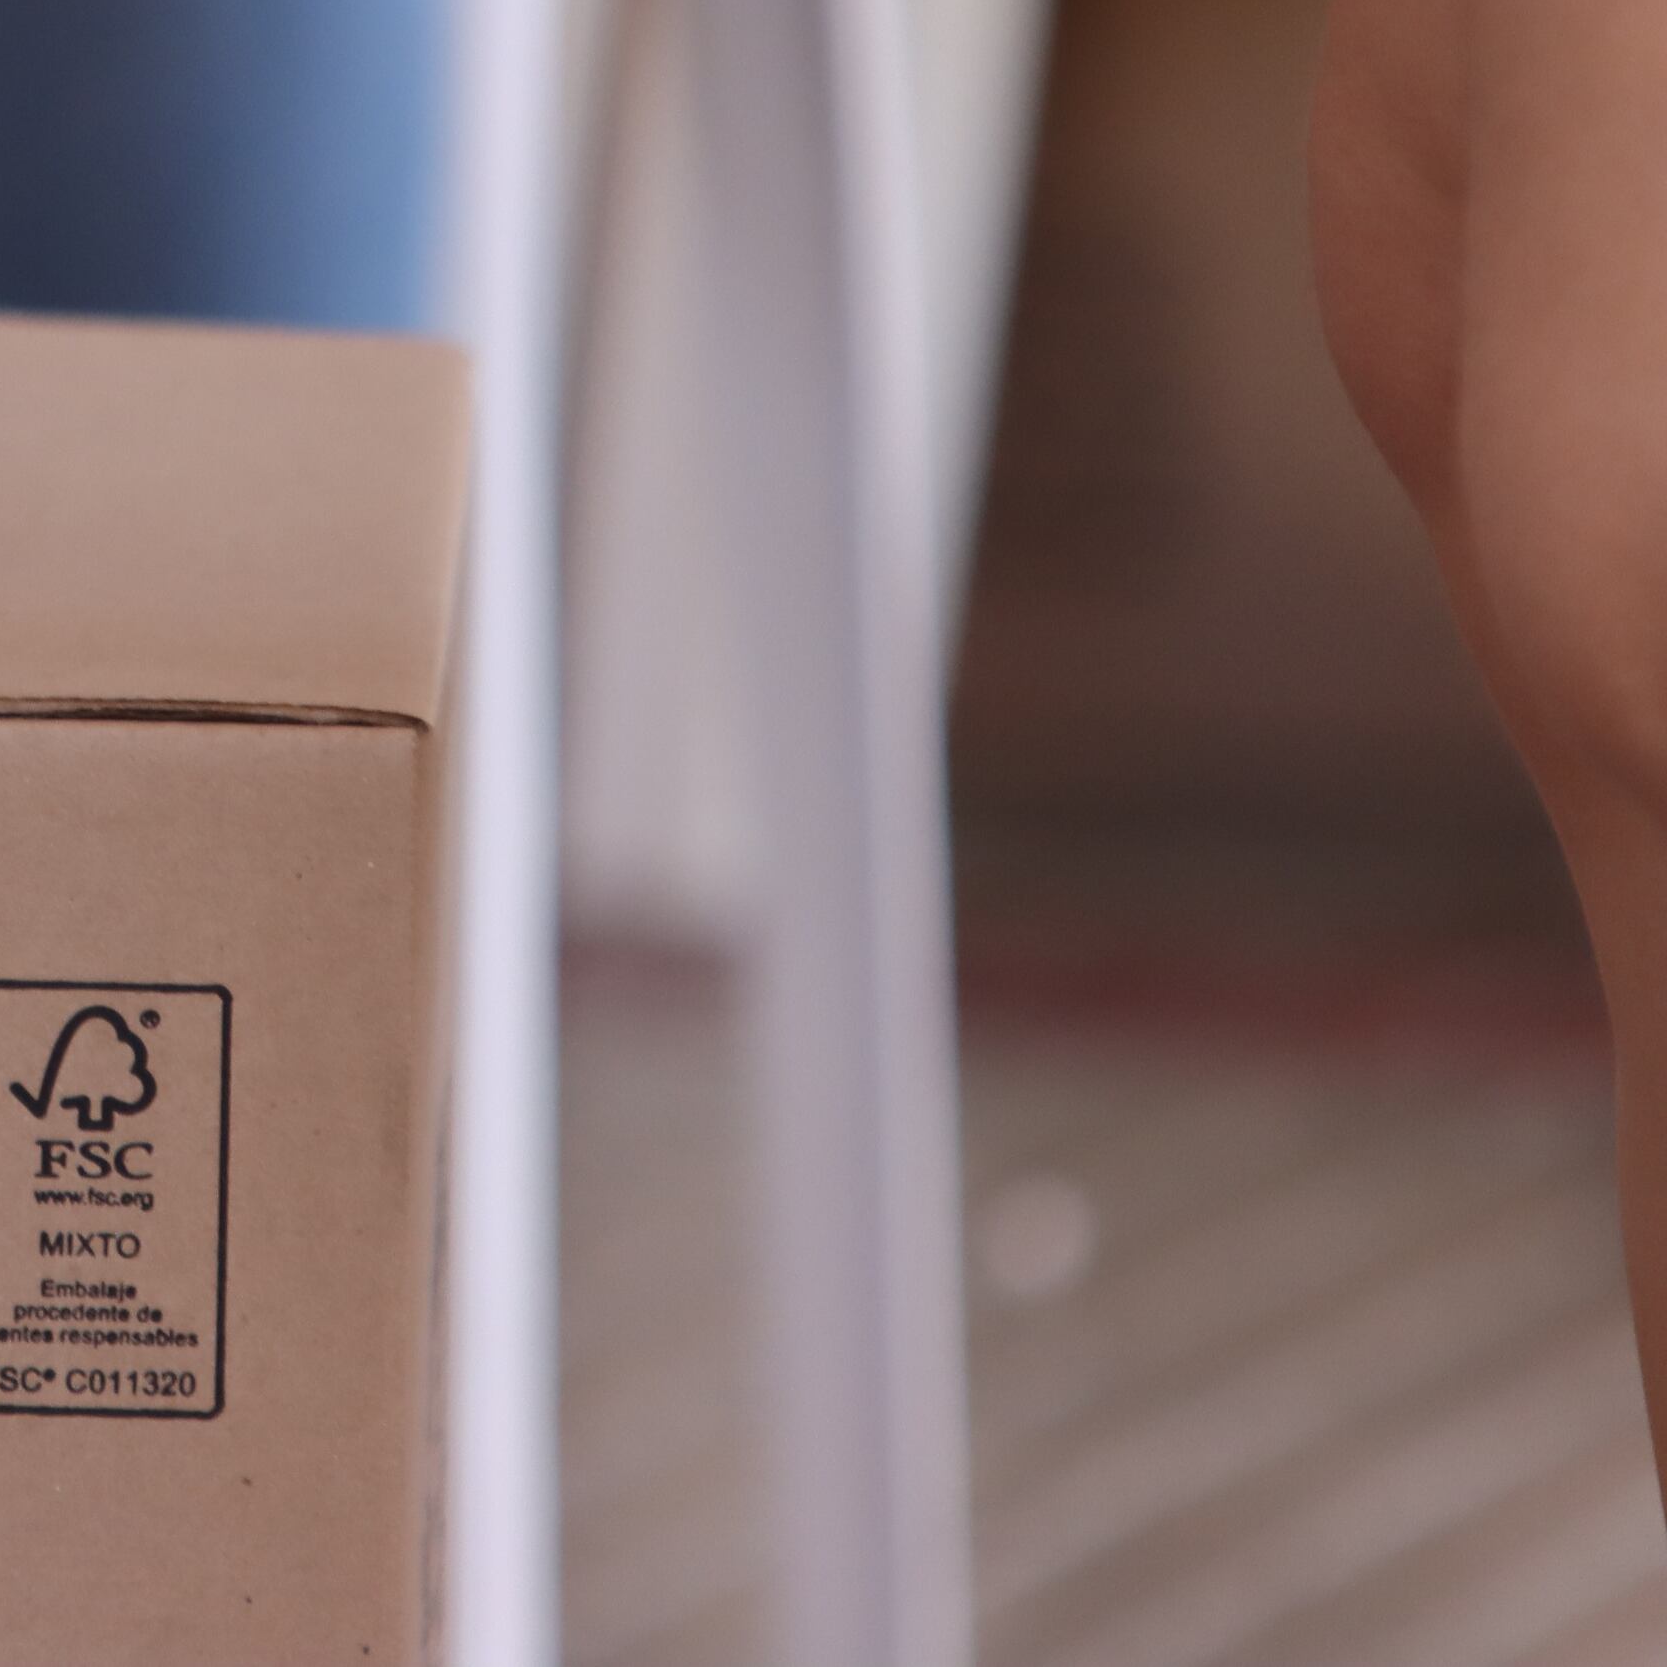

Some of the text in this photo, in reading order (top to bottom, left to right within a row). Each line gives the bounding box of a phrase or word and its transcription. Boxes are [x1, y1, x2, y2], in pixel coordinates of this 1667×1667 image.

[34, 1139, 154, 1180] FSC
[33, 1187, 154, 1212] www.fsc.org
[39, 1230, 141, 1259] MIXTO
[40, 1278, 137, 1301] Embalaje
[13, 1304, 163, 1324] procedente de
[60, 1327, 199, 1348] responsables
[64, 1368, 197, 1397] C011320
